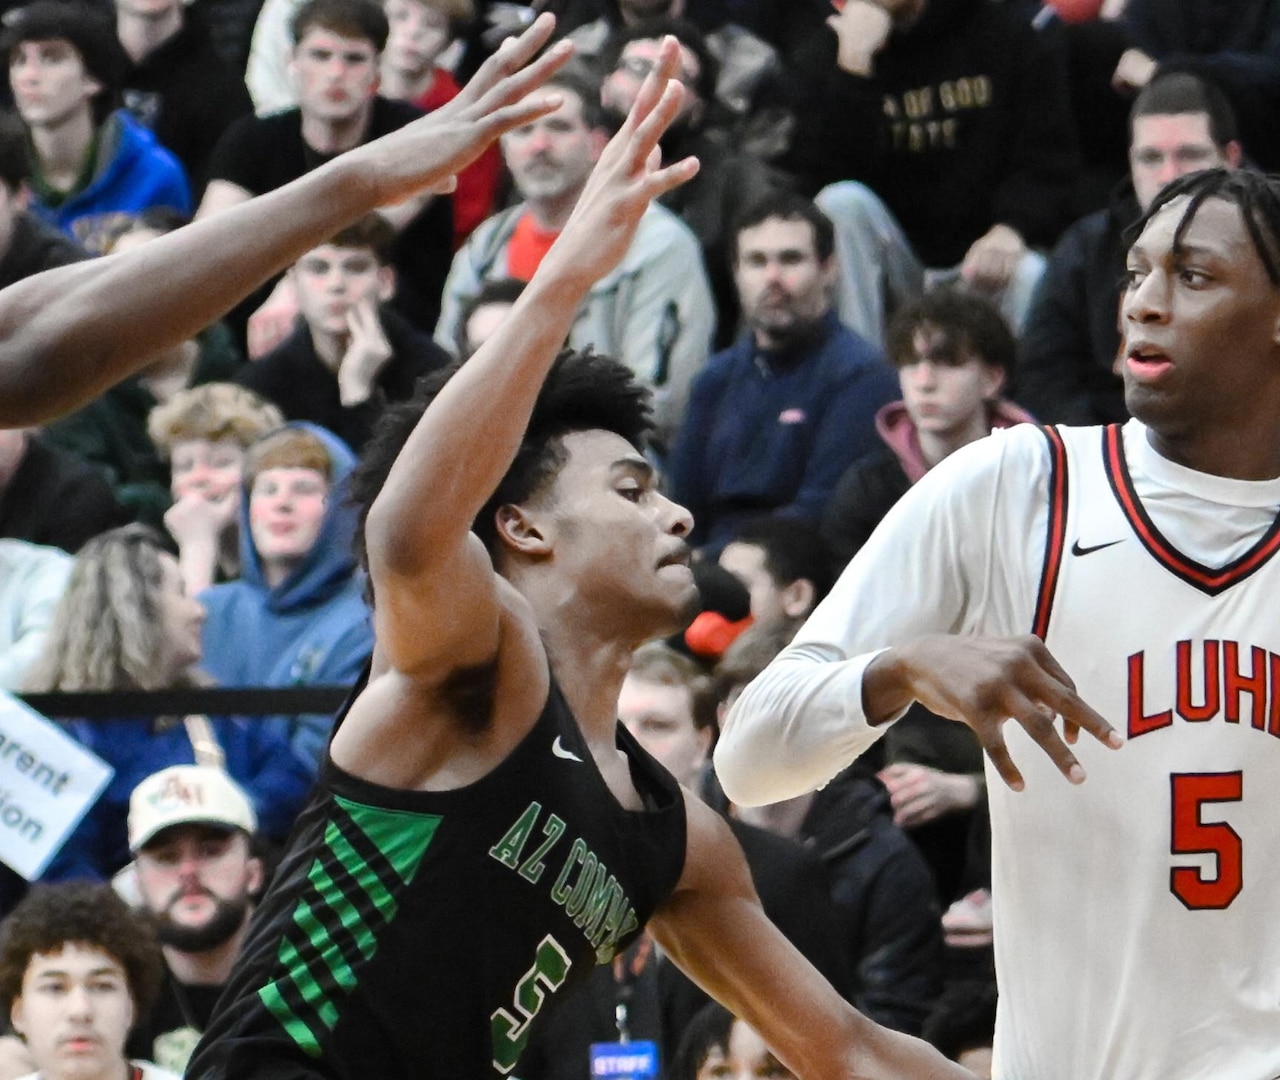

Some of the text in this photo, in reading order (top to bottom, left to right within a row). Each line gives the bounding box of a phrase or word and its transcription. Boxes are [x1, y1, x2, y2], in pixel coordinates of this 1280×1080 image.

[488, 801, 567, 884] AZ
[1169, 770, 1244, 911] 5
[490, 934, 572, 1075] 5
[593, 1054, 650, 1075] STAFF
